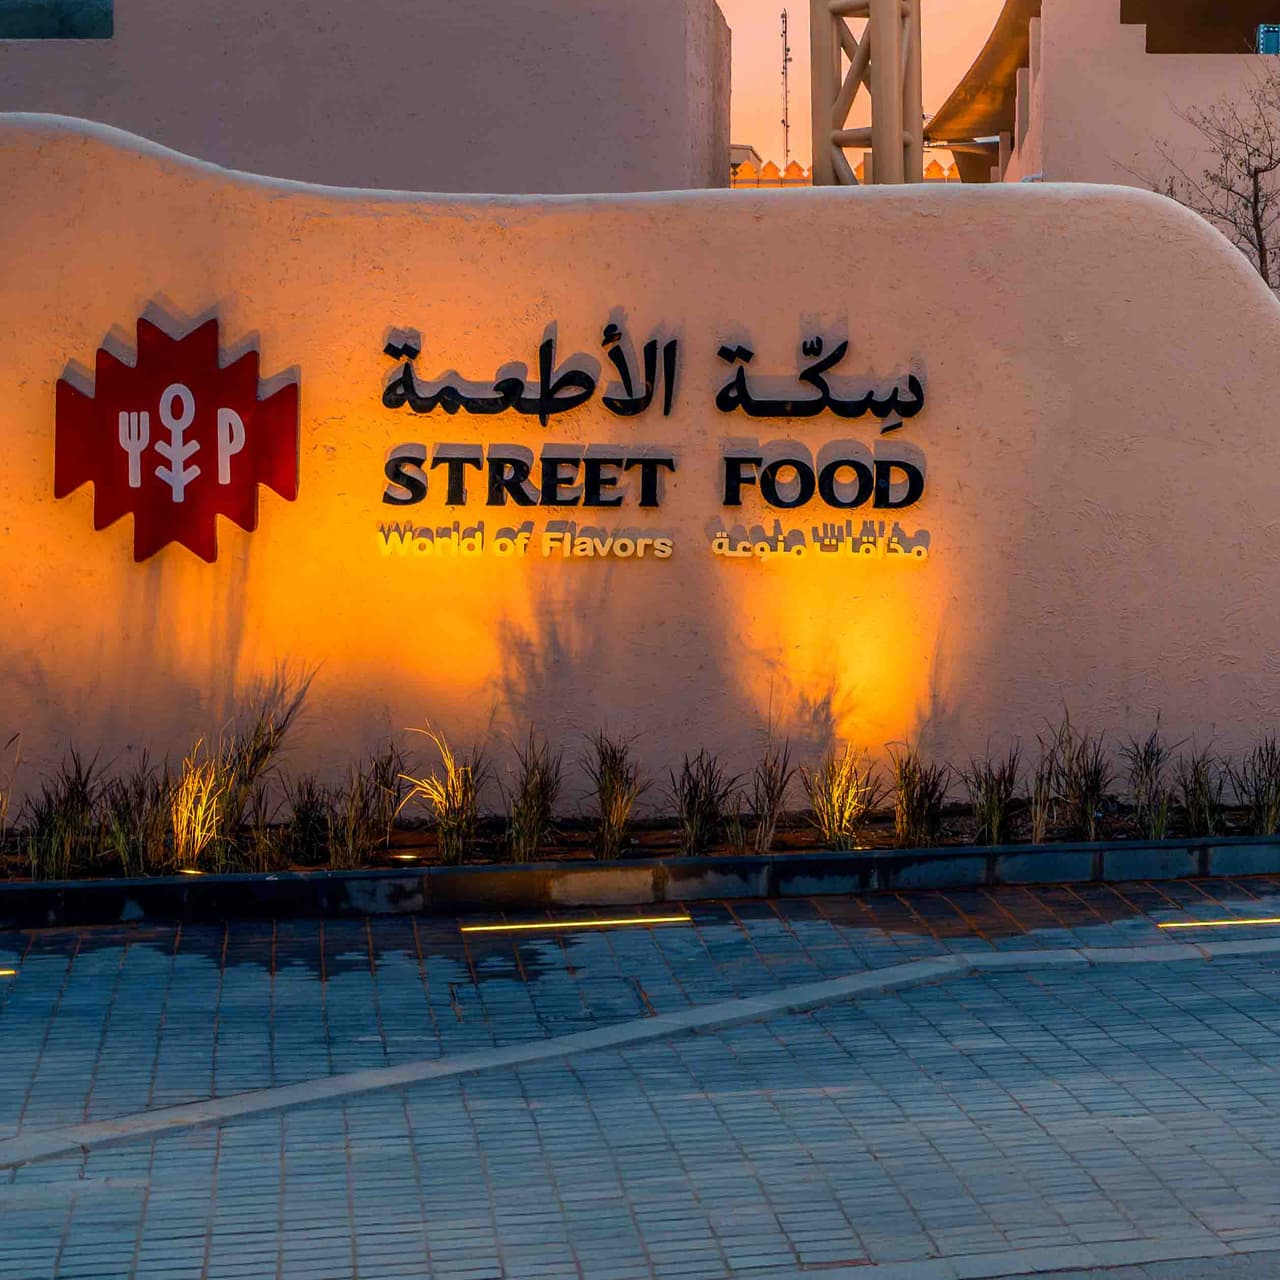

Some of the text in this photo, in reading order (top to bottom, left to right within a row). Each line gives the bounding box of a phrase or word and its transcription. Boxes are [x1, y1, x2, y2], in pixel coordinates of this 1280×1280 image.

[382, 323, 678, 428] الأطعمة
[382, 456, 926, 510] STREET FOOD
[377, 531, 674, 558] World of Flavors
[711, 531, 808, 562] منوعة
